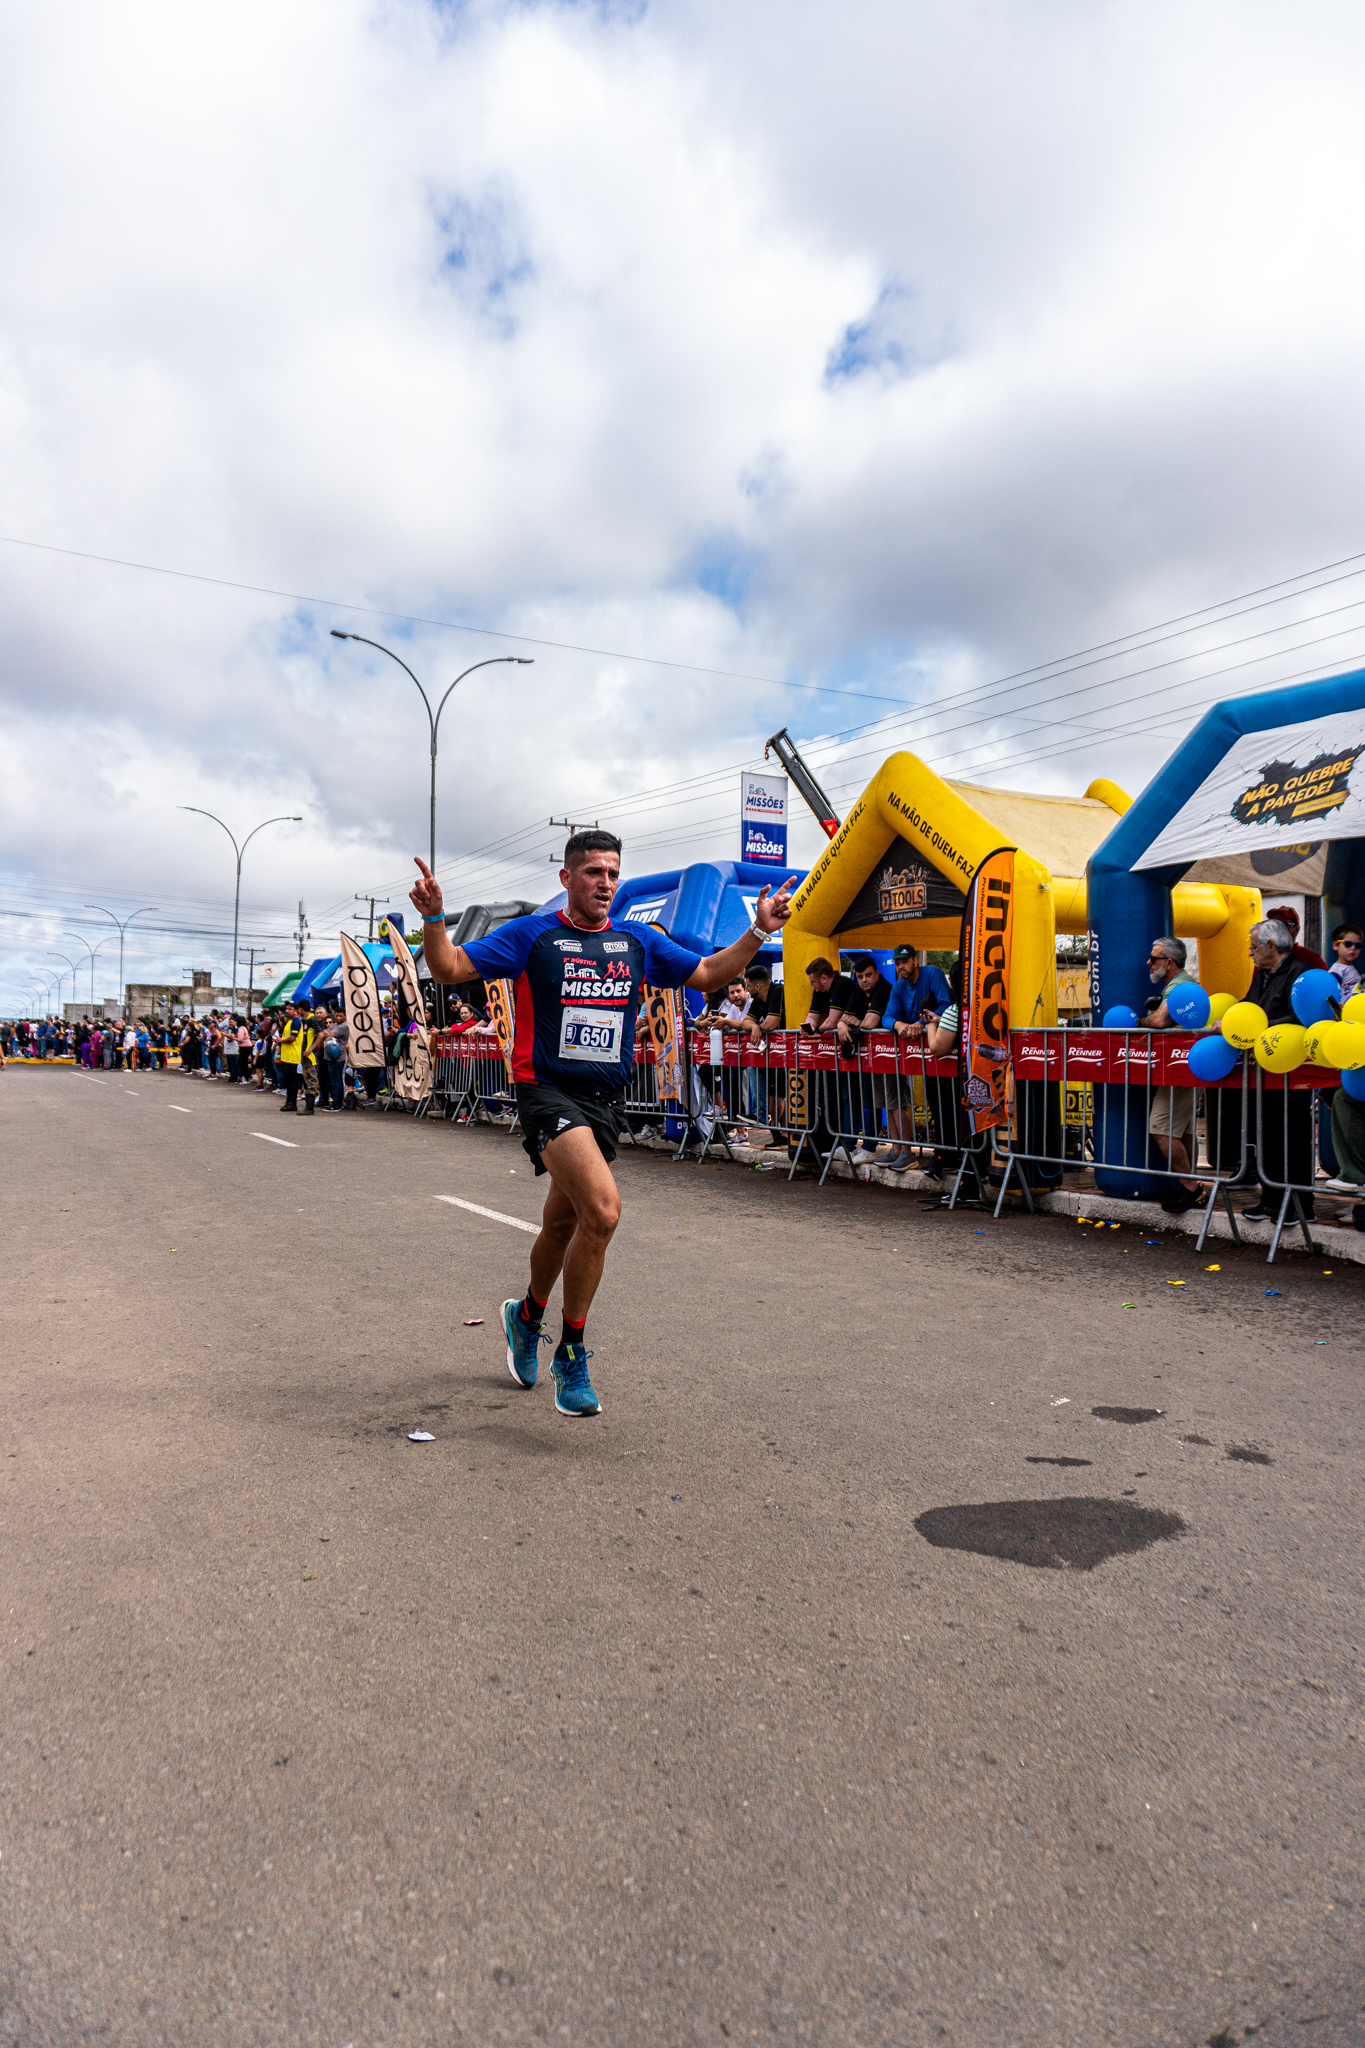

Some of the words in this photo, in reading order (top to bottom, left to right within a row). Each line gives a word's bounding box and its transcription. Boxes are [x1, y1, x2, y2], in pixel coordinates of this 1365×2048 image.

[1241, 784, 1279, 804] NÃO
[1284, 757, 1355, 791] QUEBRE
[746, 796, 784, 810] MISSÕES
[1246, 803, 1259, 817] A
[1262, 779, 1335, 812] PAREDE!
[888, 792, 901, 810] NA
[901, 803, 920, 826] MÃO
[920, 821, 933, 838] DE
[932, 832, 957, 862] QUEM
[746, 841, 784, 855] MISSÕES
[796, 894, 807, 911] NA
[806, 870, 822, 896] MÃO
[821, 855, 831, 872] DE
[830, 824, 850, 857] QUEM
[850, 802, 866, 826] FAZ.
[882, 892, 889, 910] D
[892, 889, 924, 907] TOOLS
[571, 957, 597, 966] RÚSTICA
[561, 978, 632, 997] MISSÕES
[1177, 1002, 1194, 1015] Blukit
[580, 1027, 610, 1047] 650
[1231, 1034, 1255, 1043] Blukit
[1068, 1047, 1102, 1056] RENNER
[1067, 1093, 1076, 1109] D
